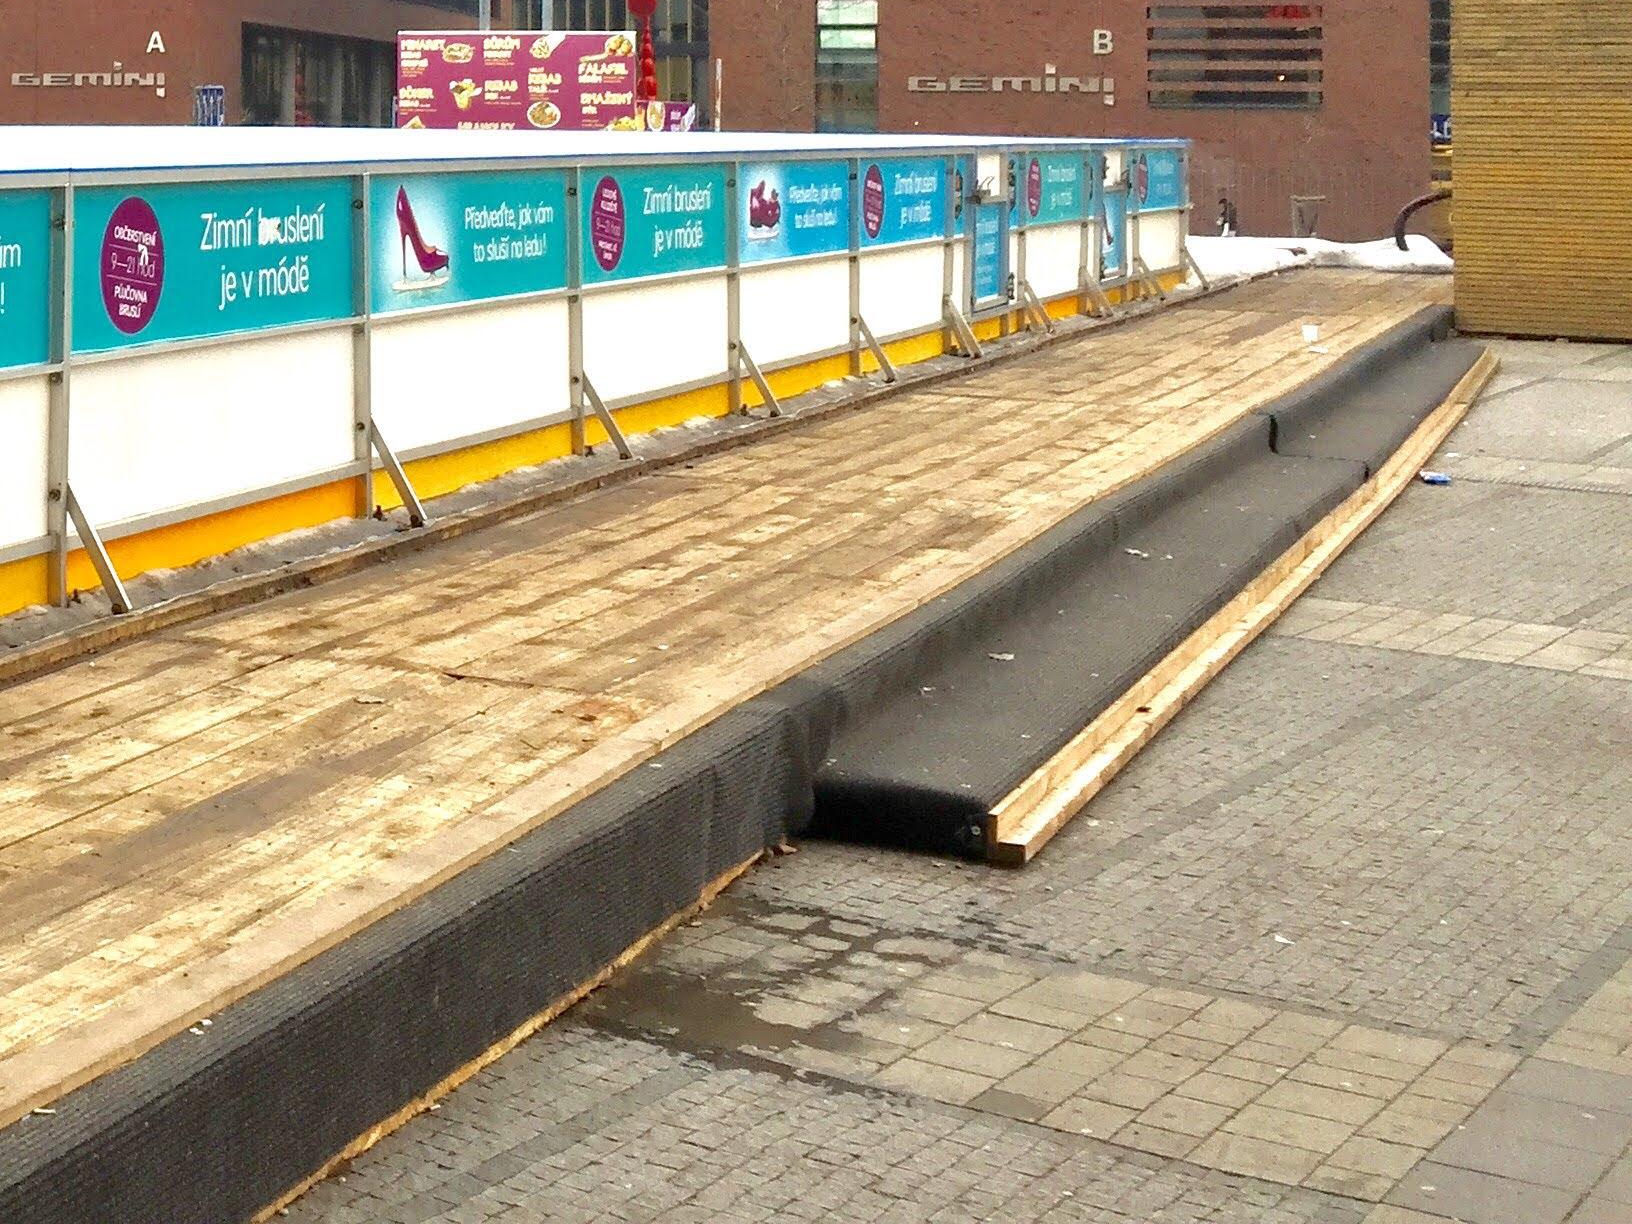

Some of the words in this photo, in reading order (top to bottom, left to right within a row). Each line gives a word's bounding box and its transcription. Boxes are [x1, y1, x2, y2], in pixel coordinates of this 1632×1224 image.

[146, 31, 166, 53] A
[1093, 29, 1114, 55] B
[200, 207, 254, 251] Zimní
[473, 242, 485, 263] to
[218, 264, 237, 311] je
[241, 270, 254, 298] v
[258, 255, 309, 297] módě
